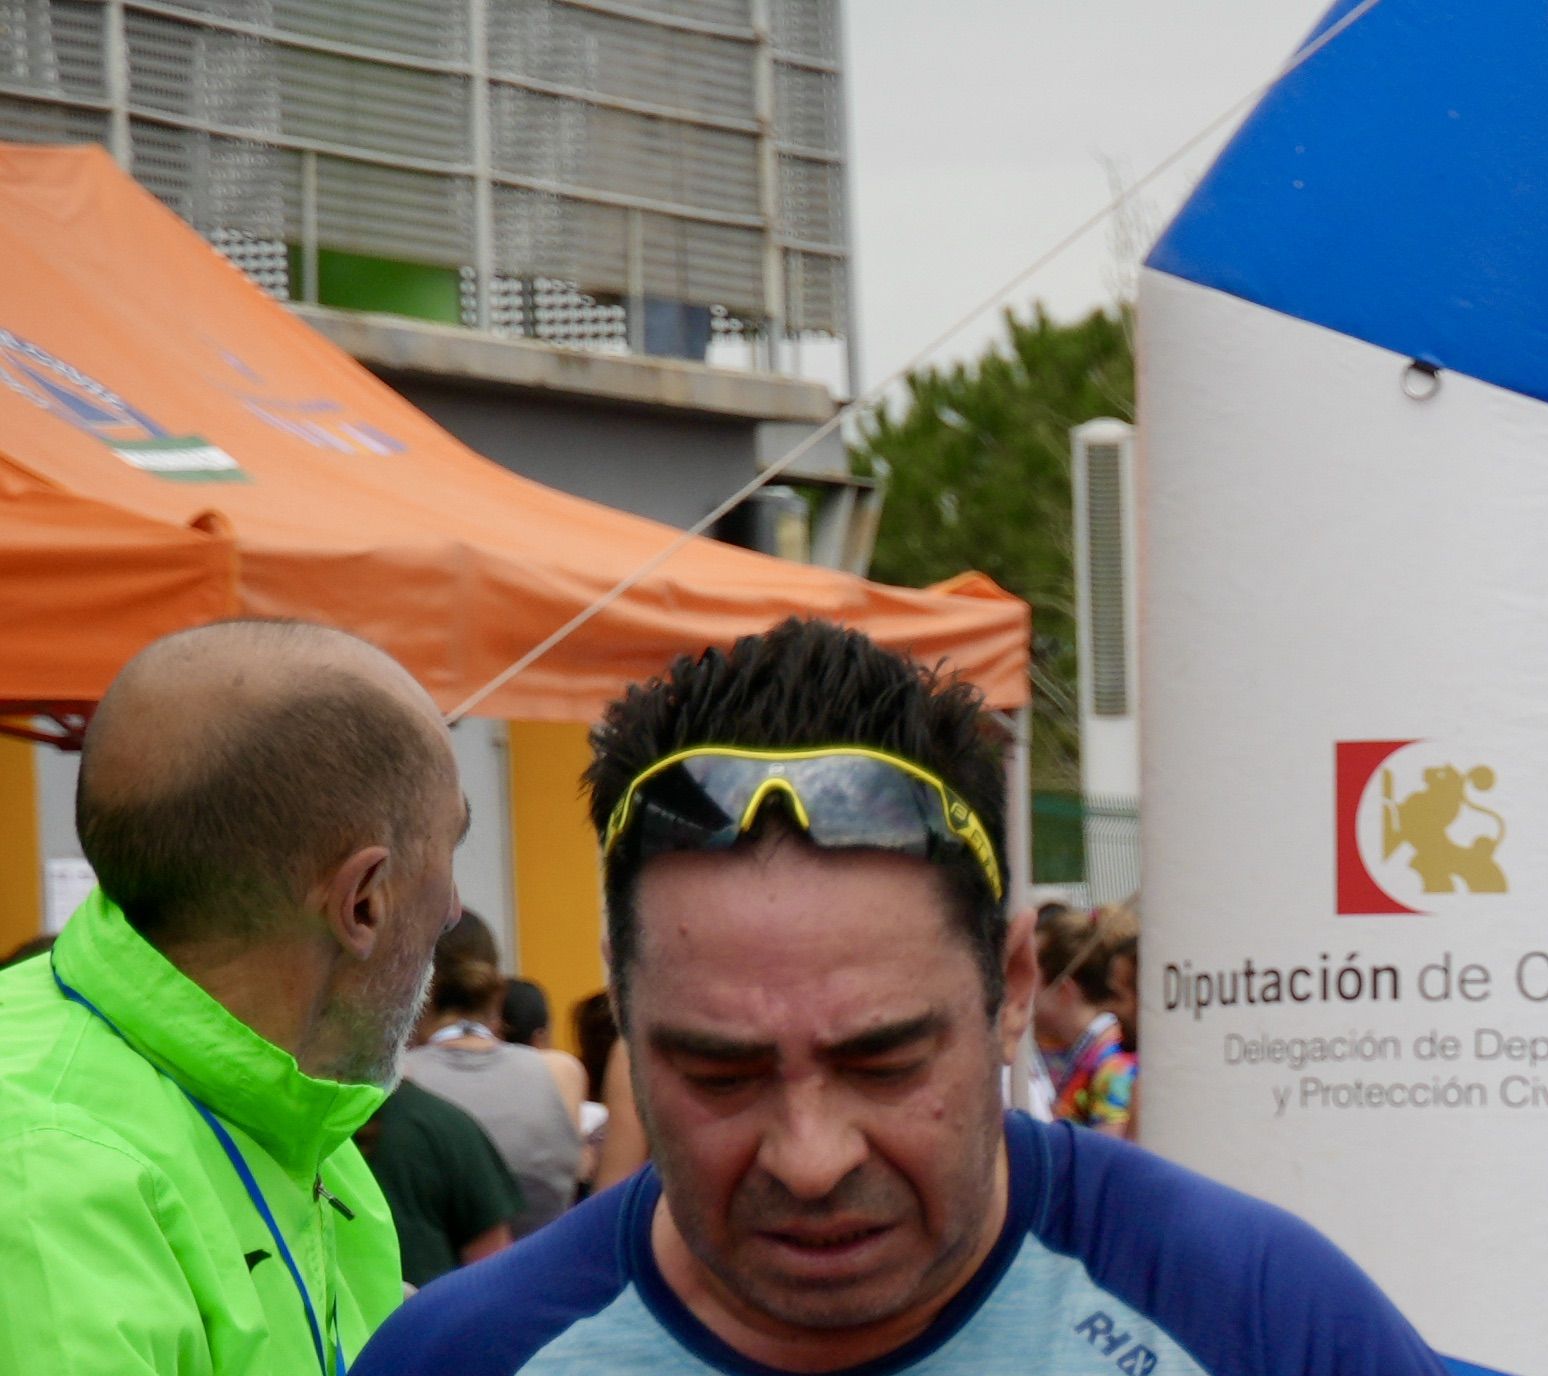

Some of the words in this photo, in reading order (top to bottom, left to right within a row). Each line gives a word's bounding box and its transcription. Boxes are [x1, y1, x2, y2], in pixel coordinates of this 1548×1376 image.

[1163, 951, 1401, 1021] Diputación
[1416, 952, 1493, 1002] de
[1223, 1030, 1401, 1070] Delegación
[1412, 1029, 1461, 1062] de
[1272, 1083, 1290, 1117] y
[1300, 1076, 1488, 1109] Protección
